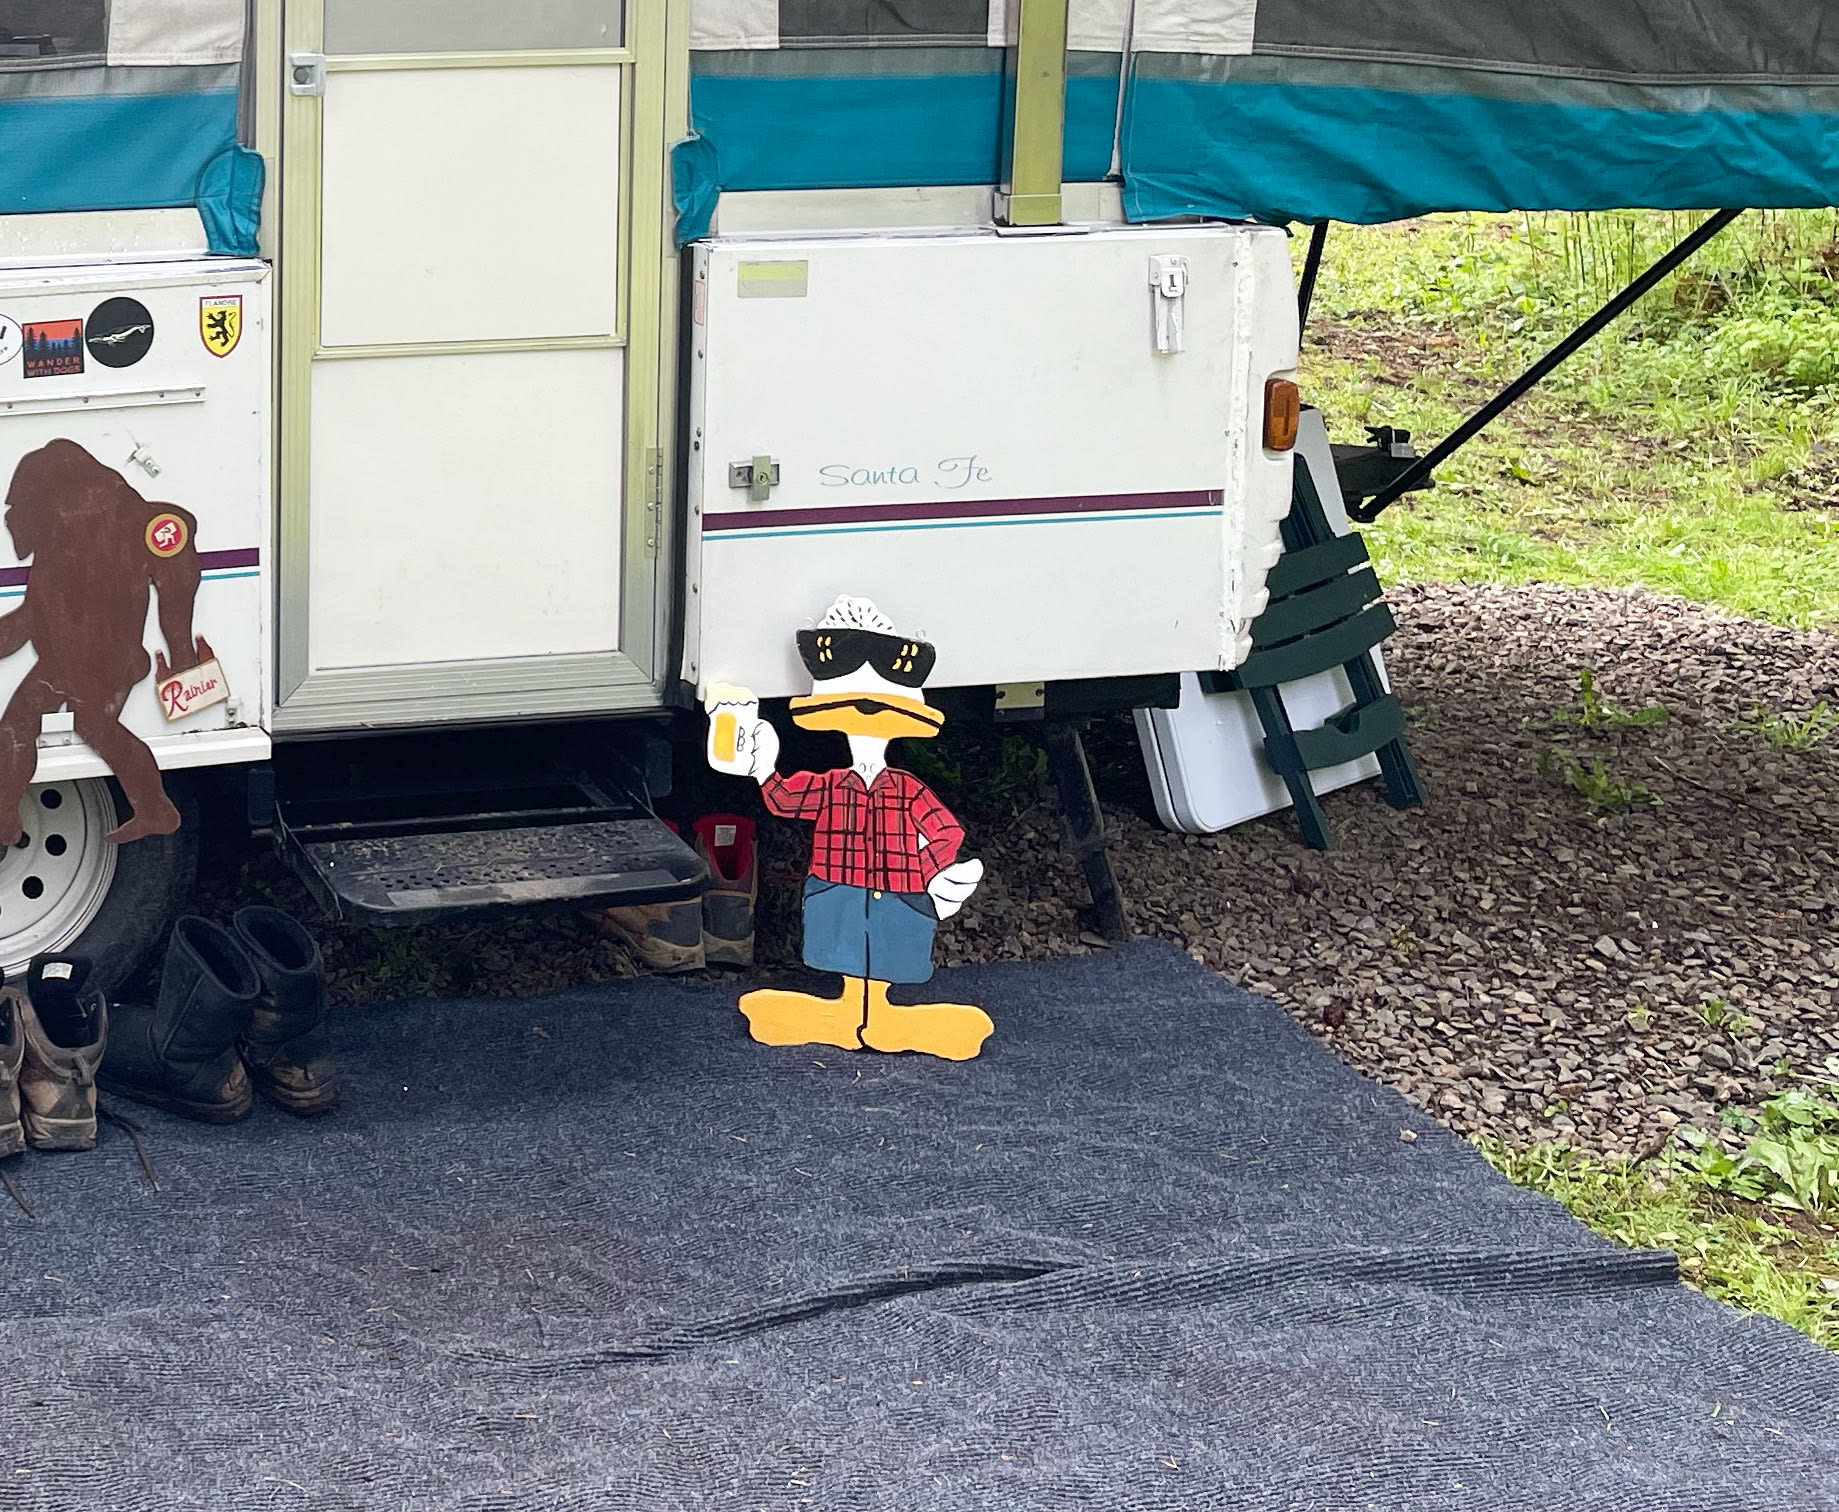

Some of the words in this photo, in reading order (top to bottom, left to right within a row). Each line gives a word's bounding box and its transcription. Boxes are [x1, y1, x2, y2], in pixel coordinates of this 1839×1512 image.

[26, 355, 81, 368] WANDER
[26, 368, 52, 377] WITH
[819, 464, 921, 487] Santa
[934, 454, 993, 489] Fe
[160, 679, 218, 718] Rainier
[736, 725, 746, 752] B
